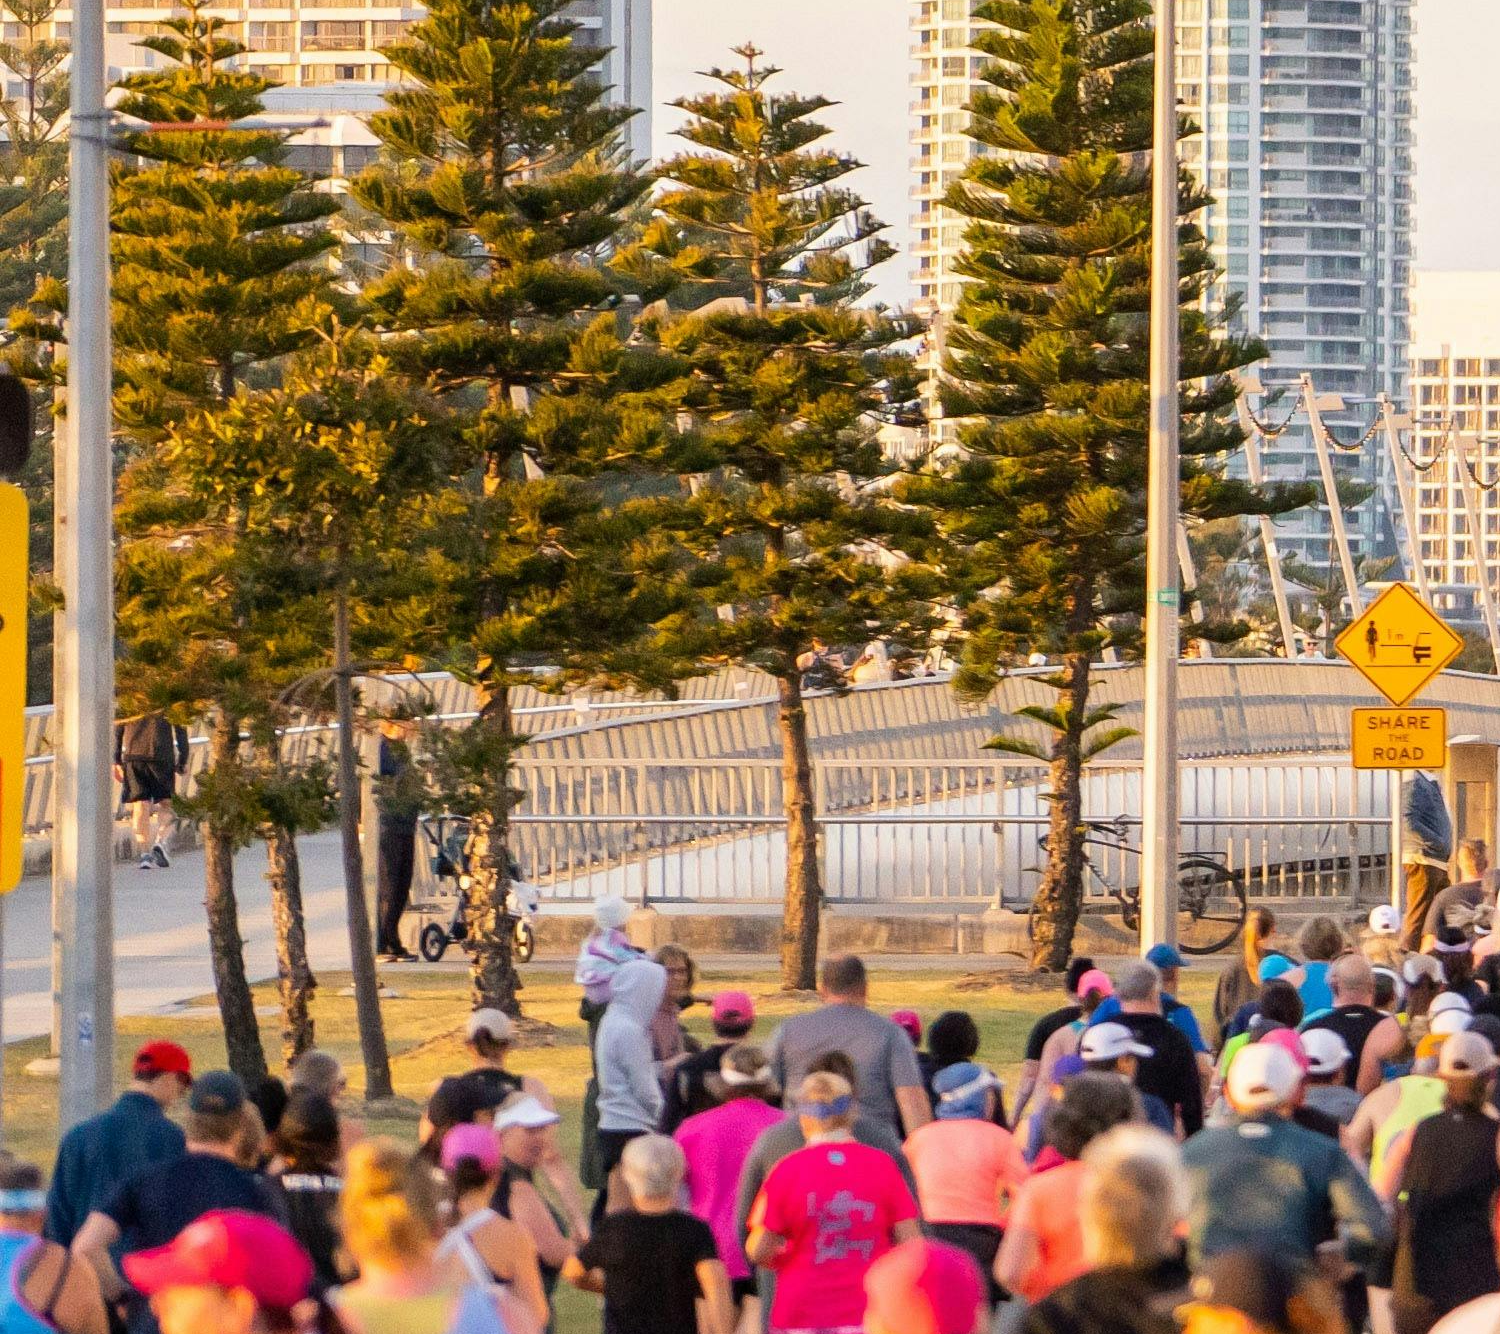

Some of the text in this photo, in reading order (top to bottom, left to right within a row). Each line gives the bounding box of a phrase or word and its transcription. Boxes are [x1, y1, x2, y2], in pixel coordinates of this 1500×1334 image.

[1367, 715, 1431, 730] SHARE
[1389, 733, 1410, 743] THE
[1373, 747, 1425, 761] ROAD
